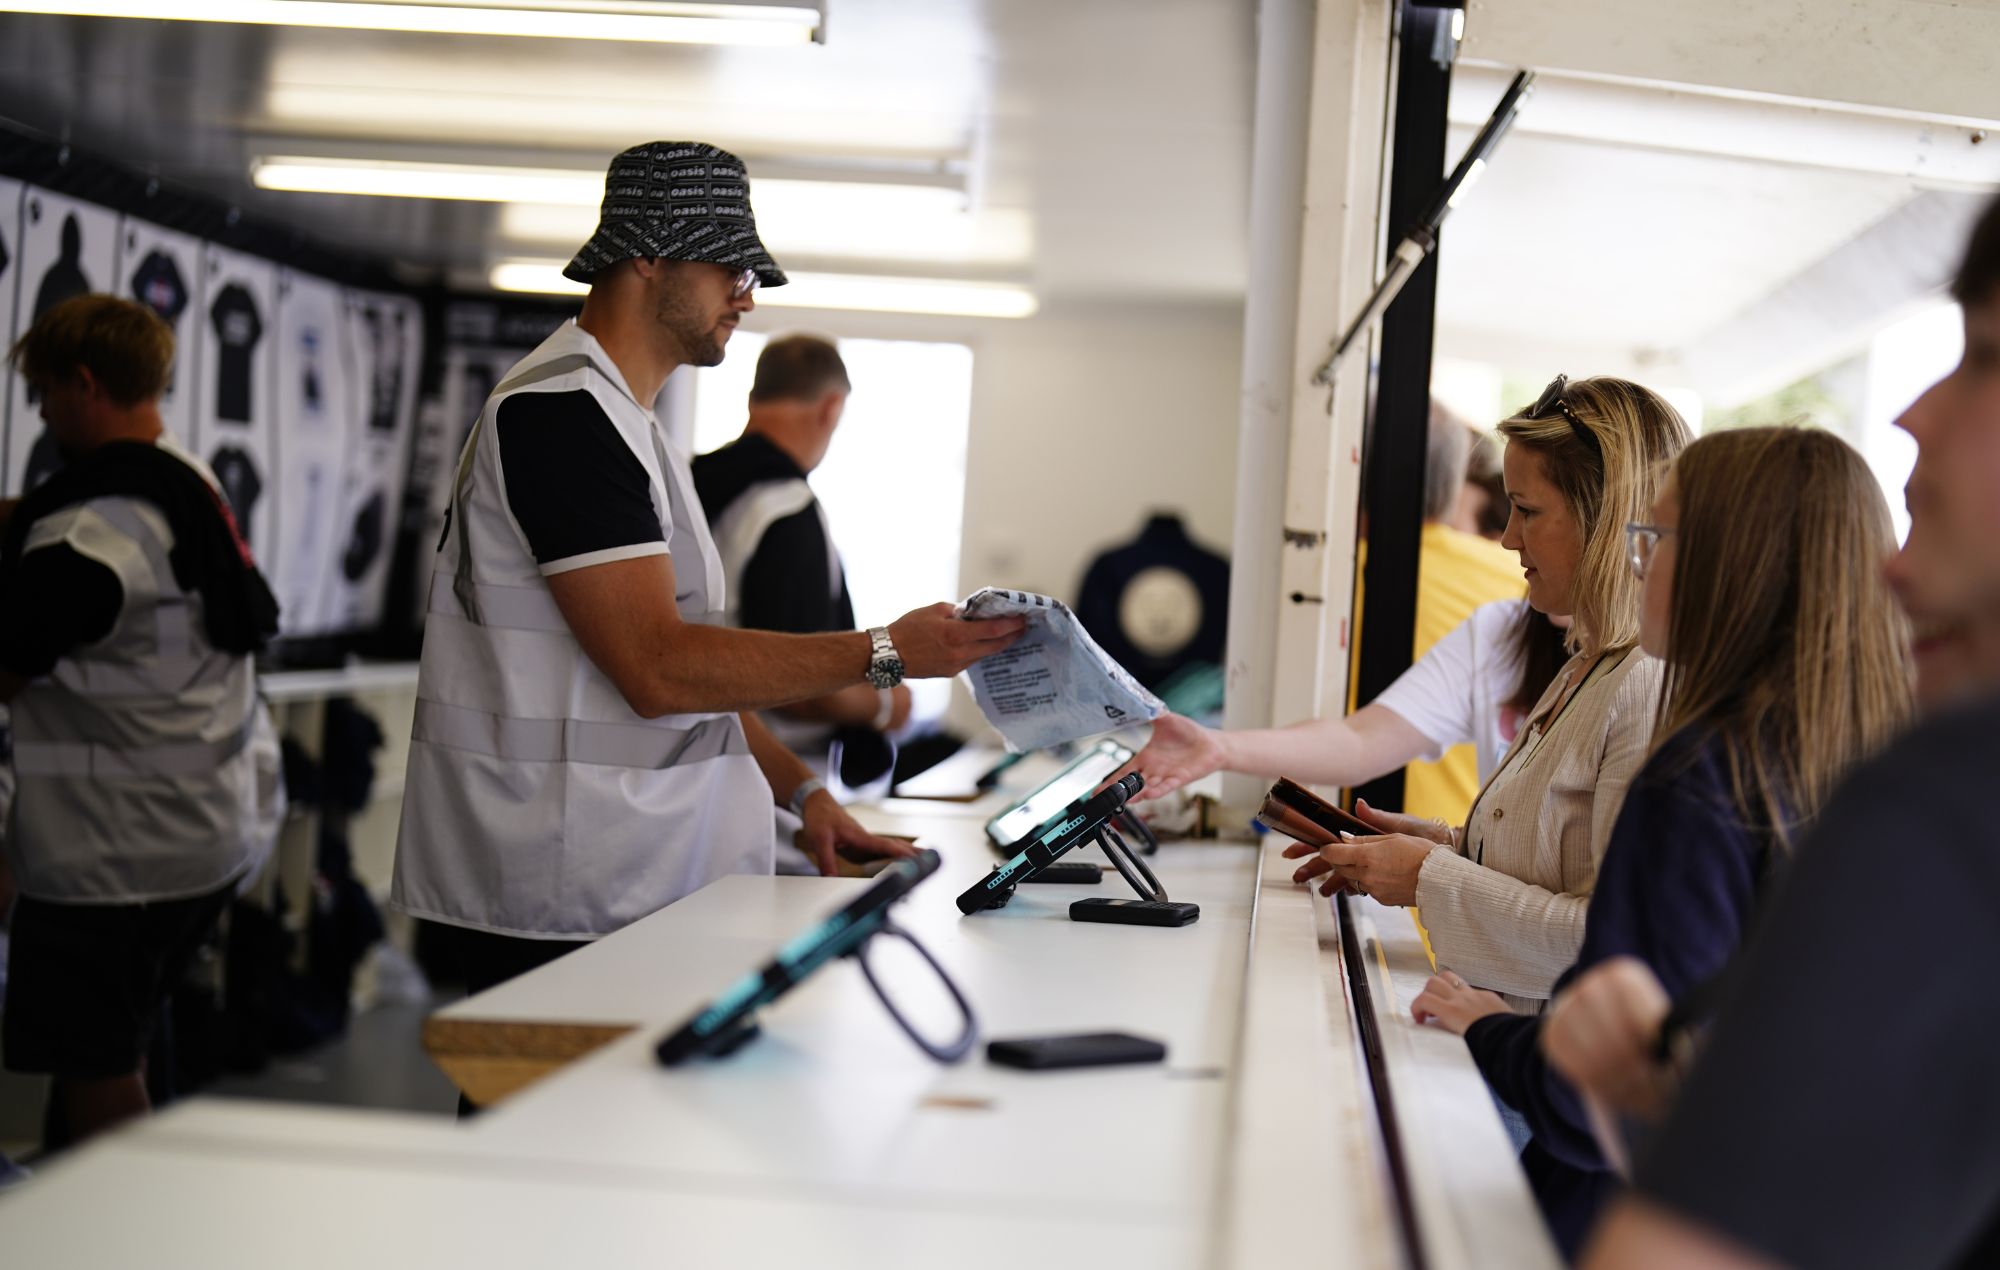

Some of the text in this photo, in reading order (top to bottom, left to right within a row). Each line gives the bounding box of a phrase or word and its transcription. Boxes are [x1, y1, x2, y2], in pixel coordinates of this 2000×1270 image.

[670, 165, 705, 178] oasis
[671, 185, 705, 197] oasis
[712, 186, 743, 197] oasis
[673, 204, 708, 216] oasis
[715, 205, 745, 216] oasis
